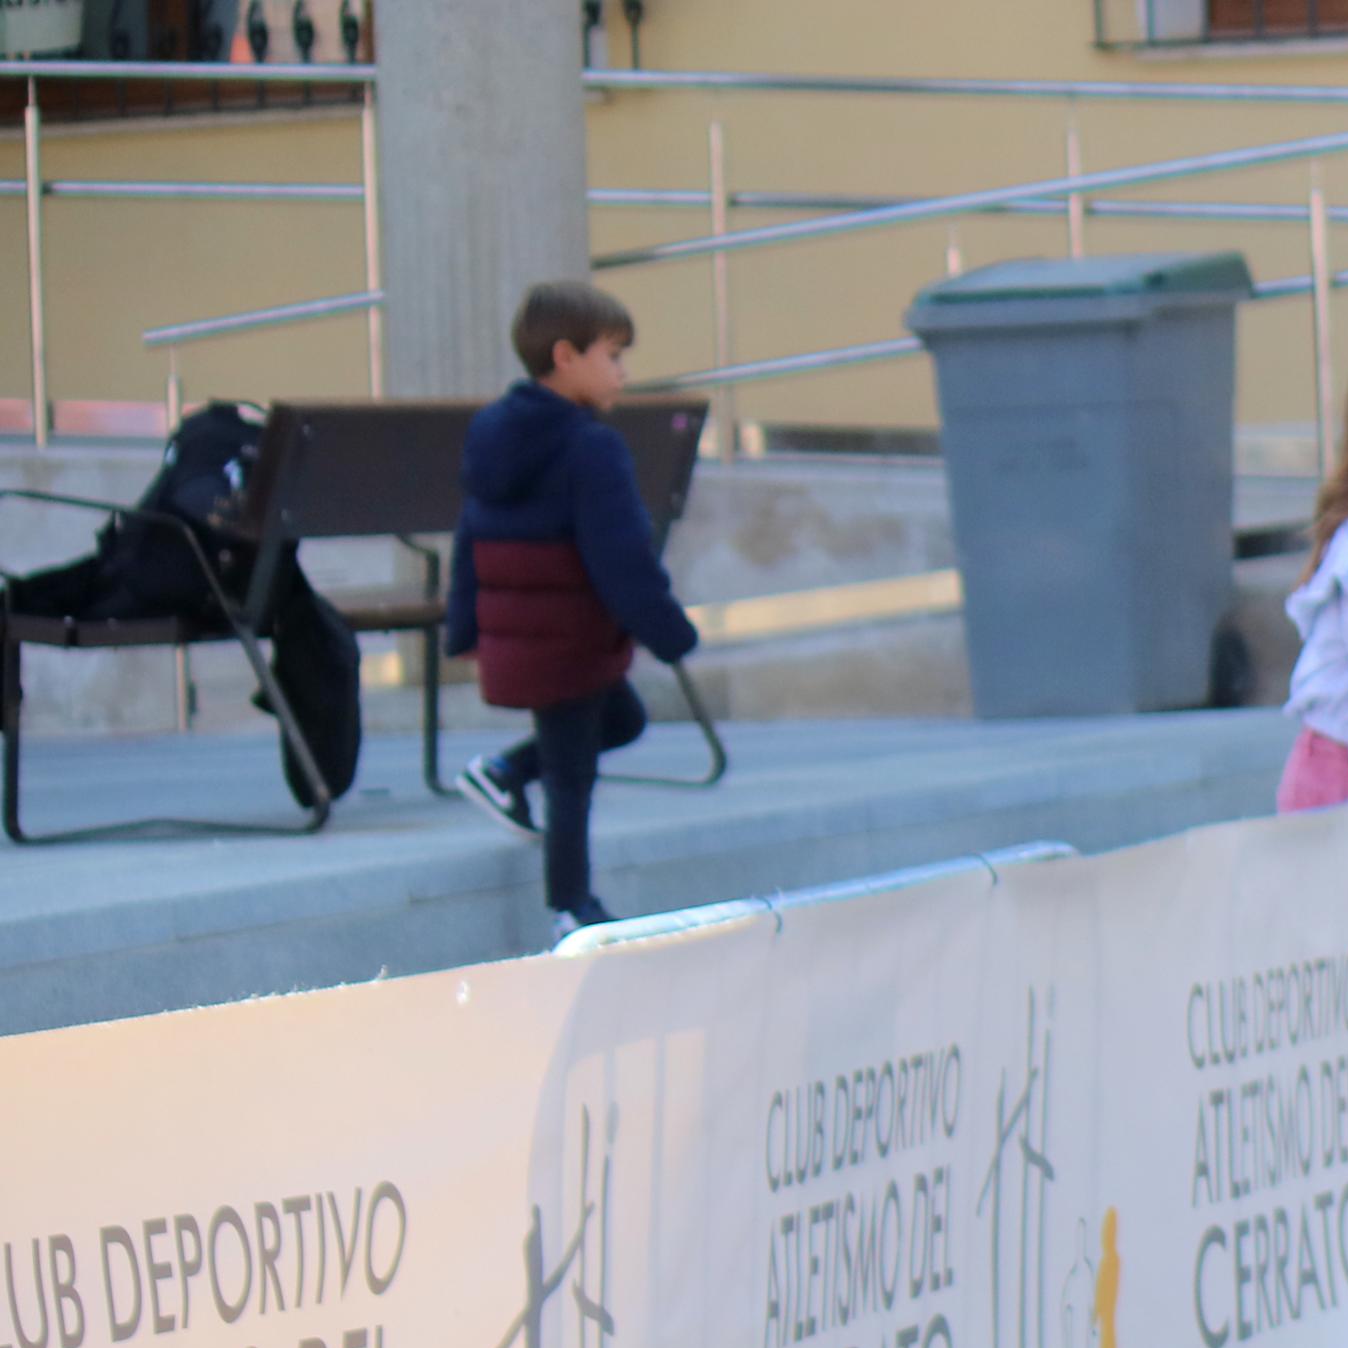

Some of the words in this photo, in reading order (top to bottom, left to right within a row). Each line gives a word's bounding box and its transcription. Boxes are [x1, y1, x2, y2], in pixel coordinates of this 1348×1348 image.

[1187, 975, 1249, 1070] CLUB
[765, 1080, 827, 1193] CLUB
[832, 1042, 961, 1170] DEPORTIVO
[1192, 1063, 1314, 1208] ATLETISMO
[100, 1179, 408, 1344] DEPORTIVO
[909, 1163, 954, 1300] DEL
